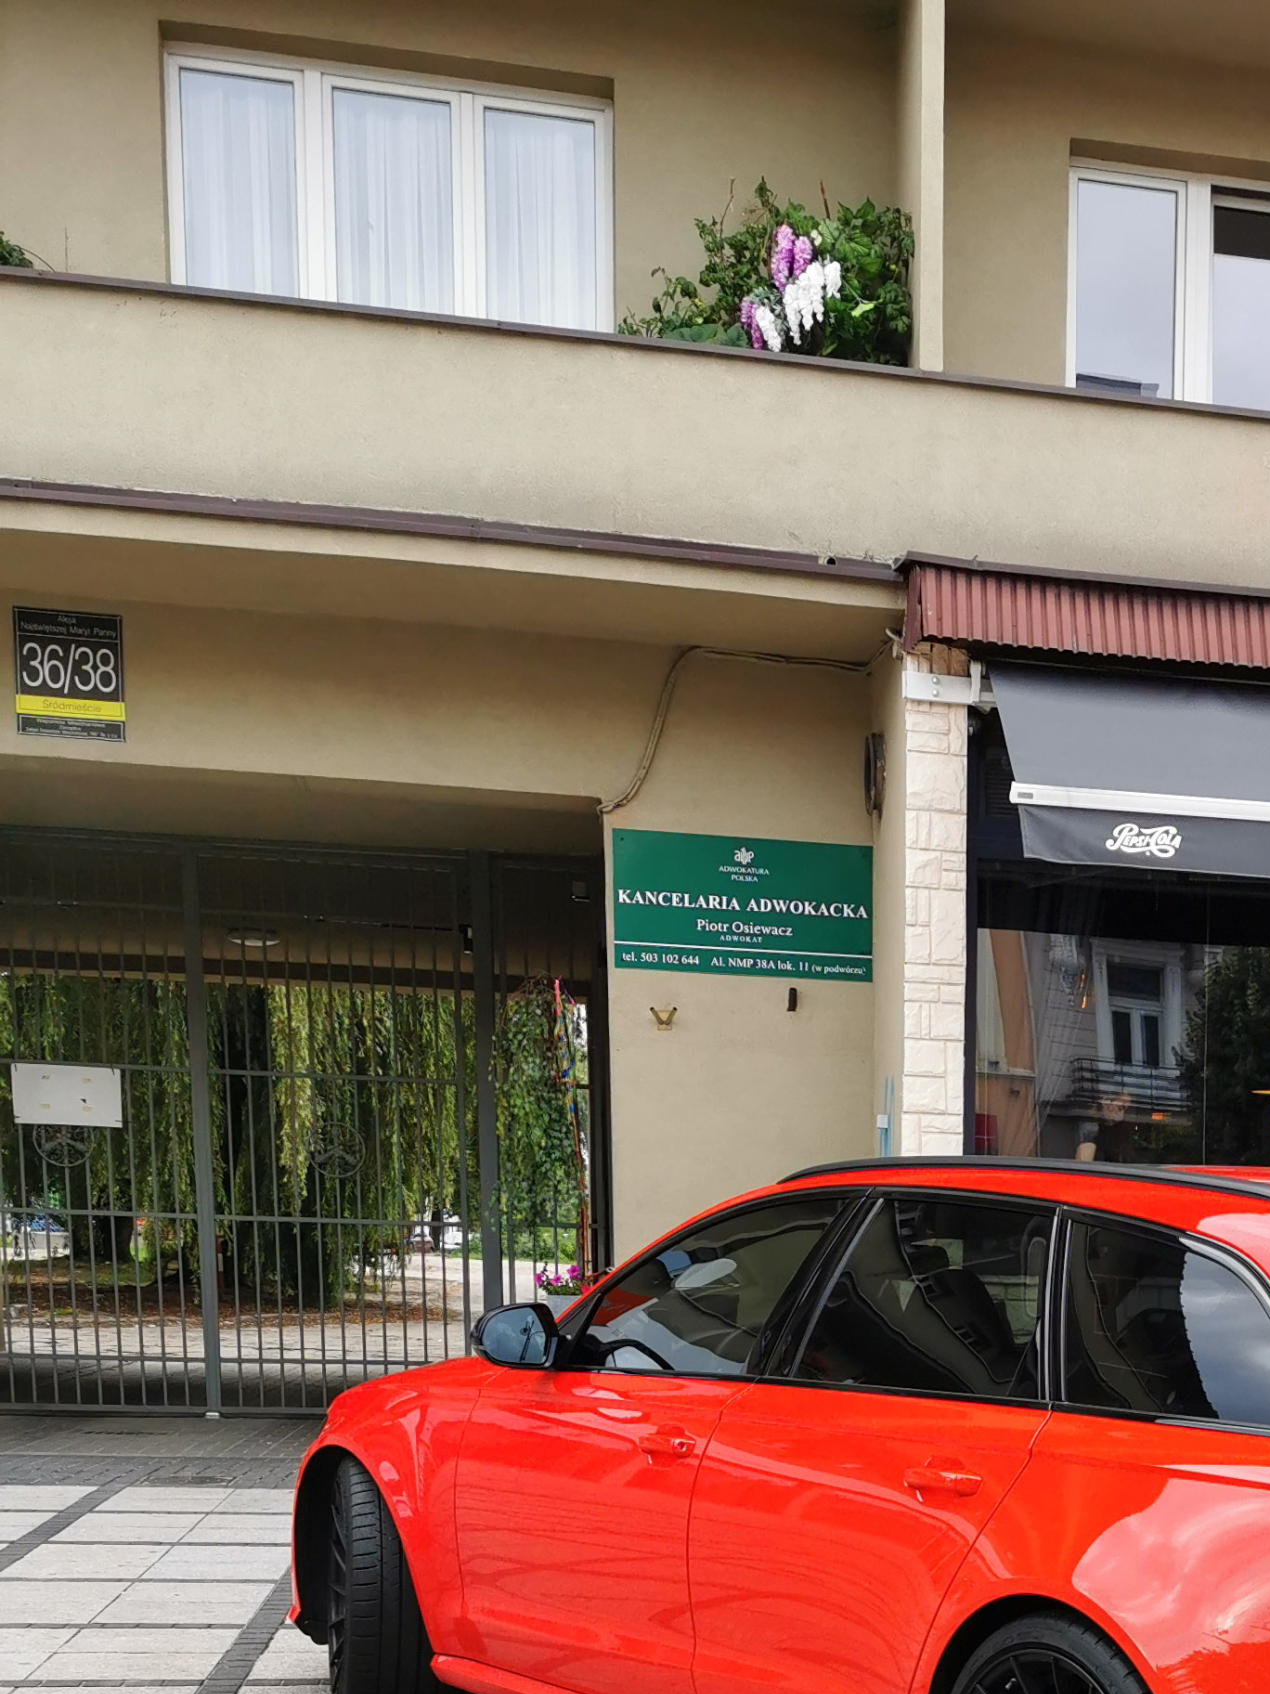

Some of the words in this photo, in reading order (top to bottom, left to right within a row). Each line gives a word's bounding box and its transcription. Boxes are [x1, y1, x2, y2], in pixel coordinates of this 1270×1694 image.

[22, 642, 117, 694] 36/38
[42, 699, 102, 713] Śródmieście
[718, 865, 770, 876] ADWOKATURA
[730, 874, 759, 883] POLSKA
[617, 888, 741, 911] KANCELARIA
[746, 897, 869, 919] ADWOKACKA
[696, 918, 729, 933] Piotr
[731, 921, 794, 937] Osiewacz
[719, 934, 763, 944] ADWOKAT
[622, 951, 638, 962] tel.
[640, 952, 658, 963] 503
[662, 953, 679, 965] 102
[681, 955, 700, 965] 644
[711, 957, 725, 967] Al.
[728, 957, 754, 969] NMP
[756, 959, 775, 970] 38A
[778, 960, 796, 971] lok.
[799, 962, 809, 972] 11
